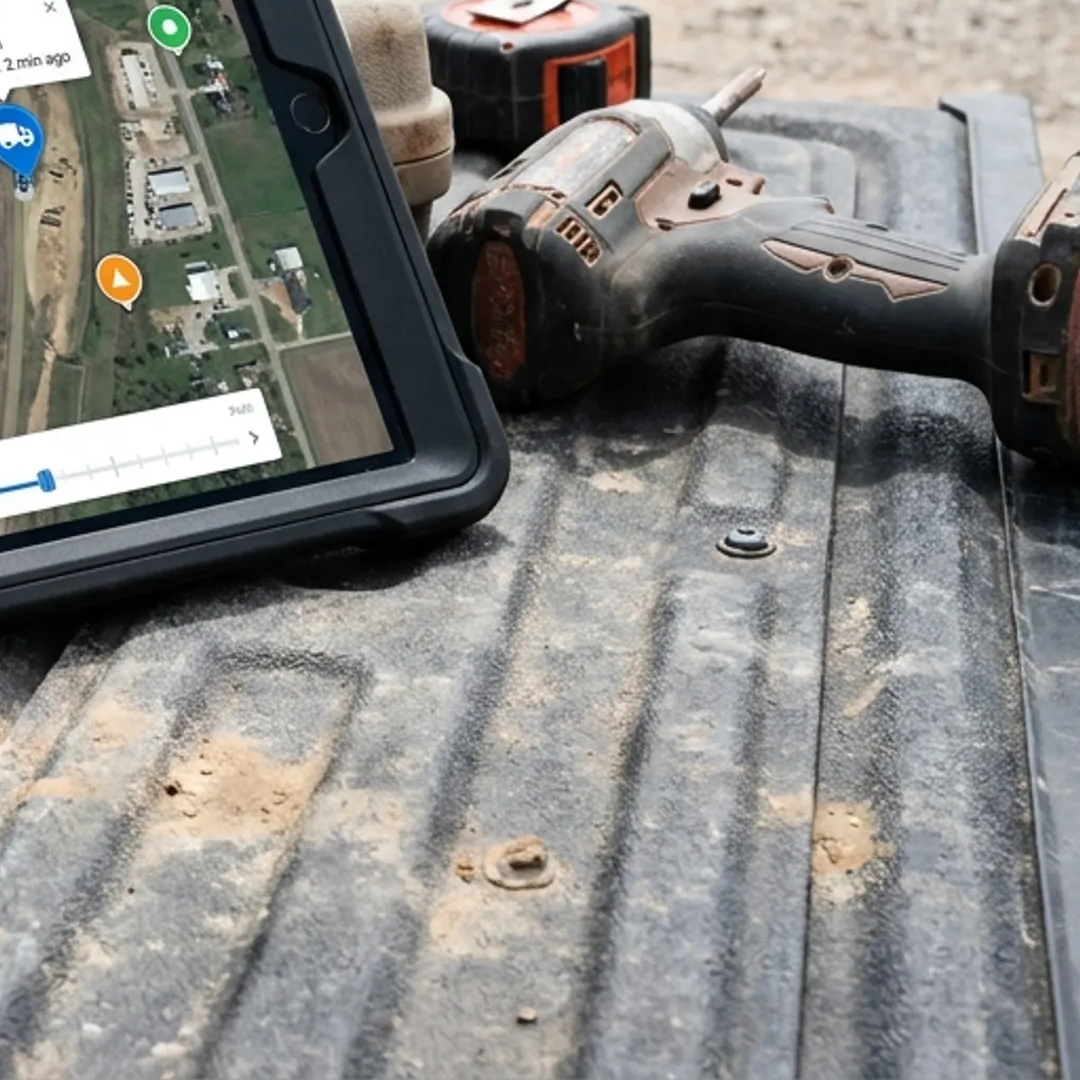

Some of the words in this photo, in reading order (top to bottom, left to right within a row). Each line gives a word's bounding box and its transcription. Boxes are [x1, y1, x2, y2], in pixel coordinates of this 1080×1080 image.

[3, 58, 15, 71] 2
[16, 53, 43, 69] min
[45, 51, 71, 69] ago
